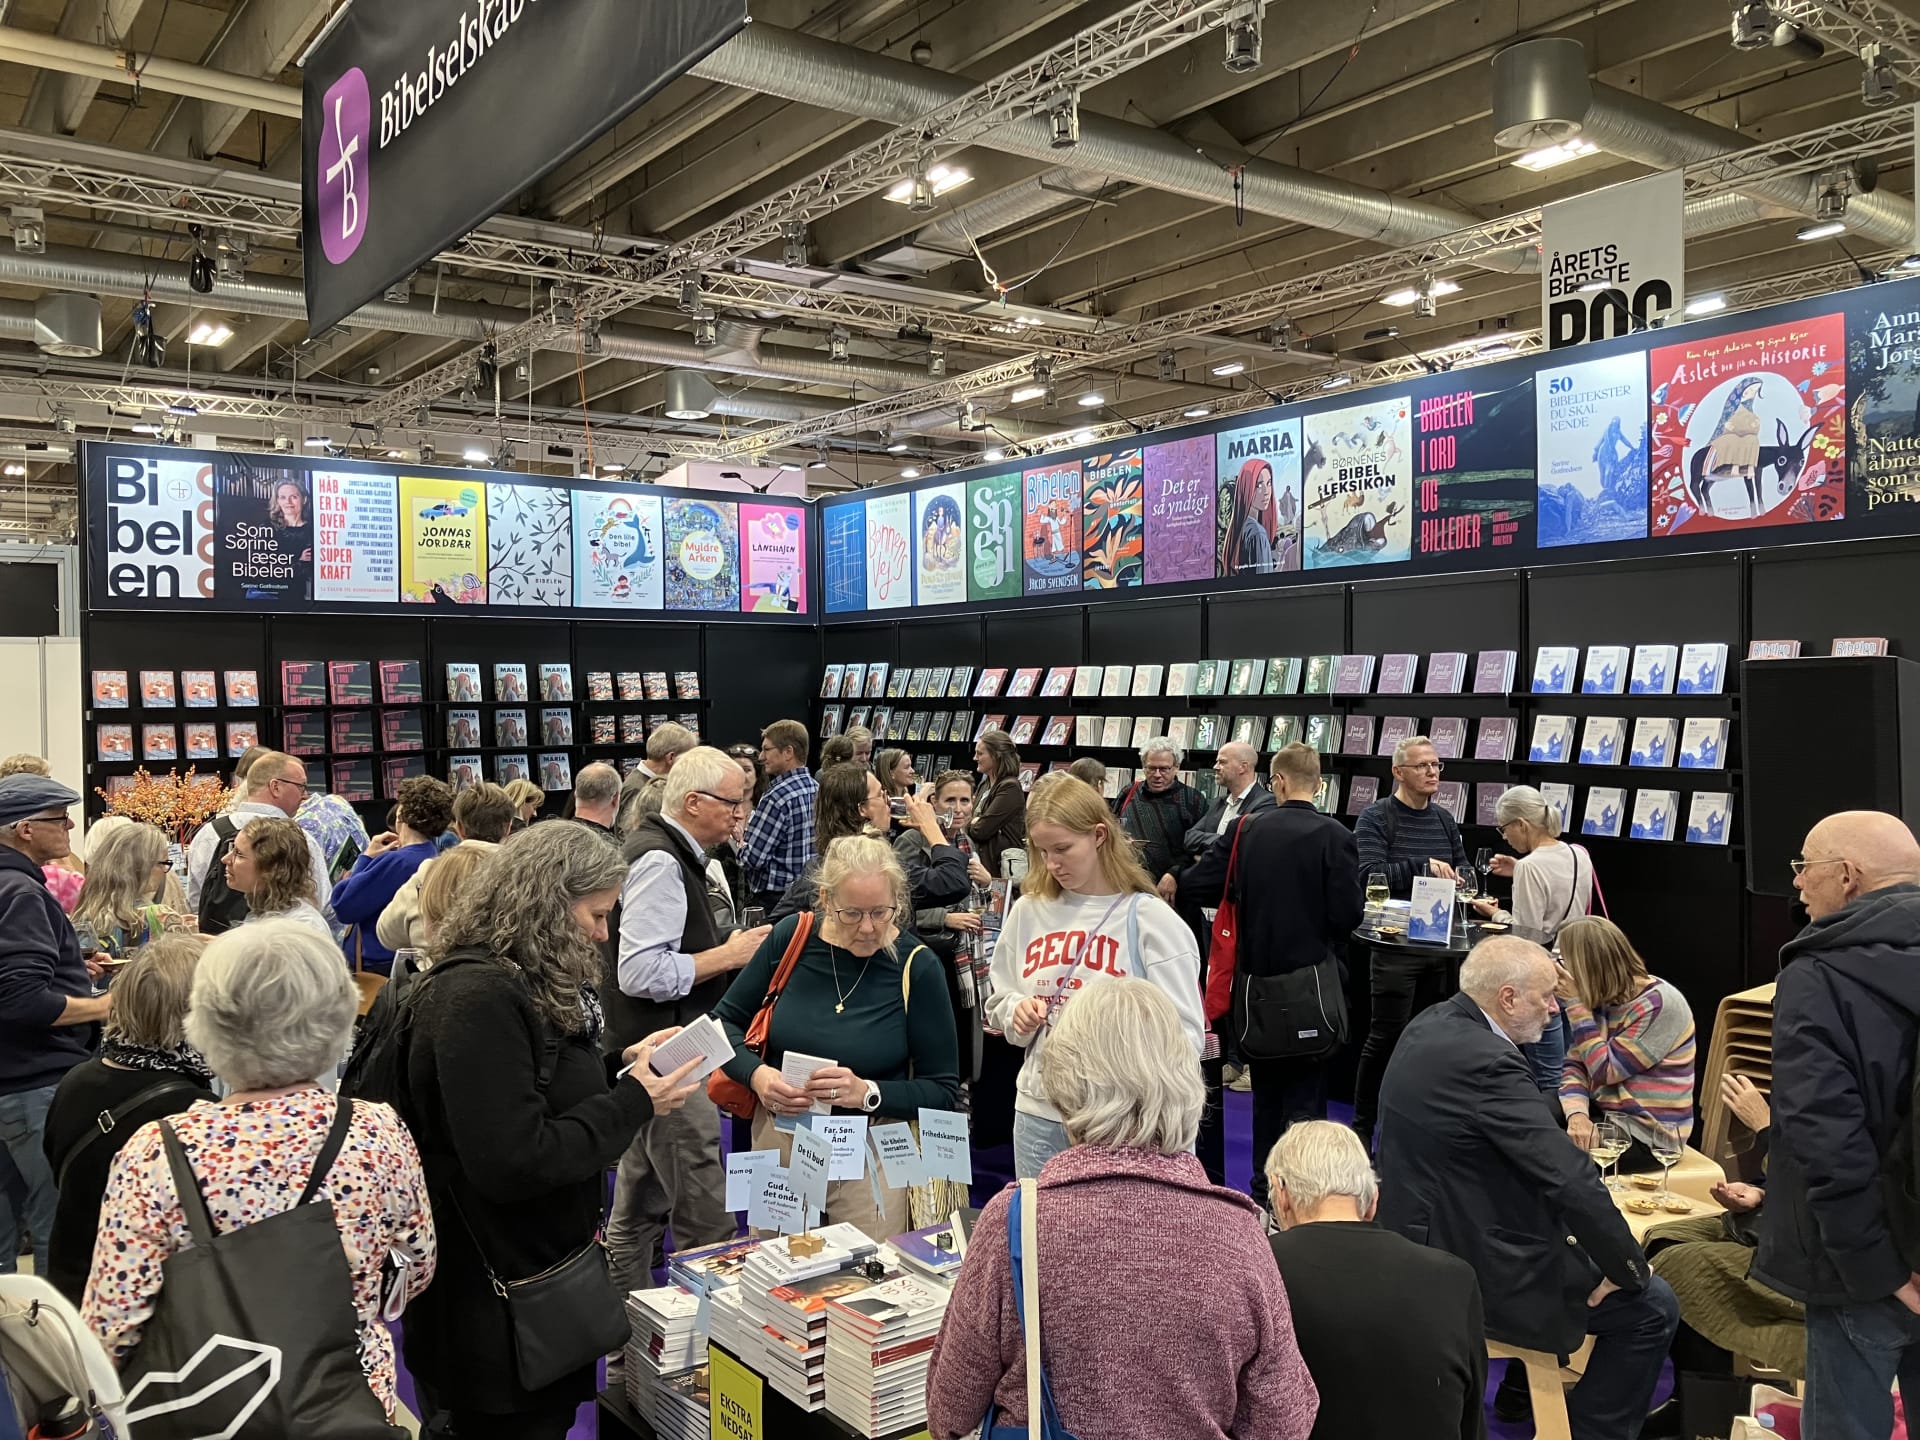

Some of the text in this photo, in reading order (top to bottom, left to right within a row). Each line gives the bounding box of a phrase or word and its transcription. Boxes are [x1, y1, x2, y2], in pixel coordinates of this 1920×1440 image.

[1549, 244, 1617, 277] ÅRETS
[1671, 358, 1718, 385] Æslet
[1549, 376, 1573, 394] 50
[1550, 384, 1631, 408] BIBELTEKSTER
[1420, 391, 1473, 433] BIBELEN
[1551, 403, 1598, 420] DU SKAL
[1551, 417, 1589, 432] KENDE
[1227, 432, 1294, 460] MARIA
[1421, 435, 1456, 473] I ORD
[1332, 452, 1386, 469] BØRNENES
[1089, 464, 1132, 481] BIBELEN
[1338, 464, 1381, 481] BIBEL
[1868, 473, 1908, 489] som
[108, 457, 159, 506] Bi
[319, 476, 339, 494] HÅB
[1162, 478, 1201, 497] Det er
[1323, 474, 1396, 497] LEKSIKON
[1027, 470, 1080, 515] Bibelen
[1421, 478, 1439, 513] OG
[1868, 489, 1911, 511] port
[319, 496, 348, 512] ER EN
[1152, 493, 1210, 519] så yndigt
[319, 513, 346, 529] OVER
[108, 506, 193, 556] bel
[236, 522, 274, 538] Som
[320, 531, 338, 546] SET
[422, 527, 472, 538] JONNAS
[1421, 514, 1481, 553] BILLEDER
[225, 534, 279, 551] Sørine
[418, 538, 471, 549] JORDBÆR
[685, 542, 720, 553] Myldre
[248, 548, 294, 565] læser
[320, 548, 352, 564] SUPER
[688, 553, 718, 563] Arken
[232, 561, 294, 579] Bibelen
[320, 565, 351, 580] KRAFT
[109, 563, 180, 598] en
[1028, 574, 1079, 591] JAKOB SVENDSEN
[1022, 930, 1127, 979] SEOUL
[831, 1133, 847, 1143] Ånd
[922, 1130, 967, 1143] Frihedskampen
[797, 1144, 806, 1156] De
[806, 1149, 813, 1159] ti
[812, 1152, 825, 1167] bud
[767, 1181, 784, 1191] Gud
[763, 1189, 799, 1203] det onde
[720, 1393, 753, 1428] EKSTRA
